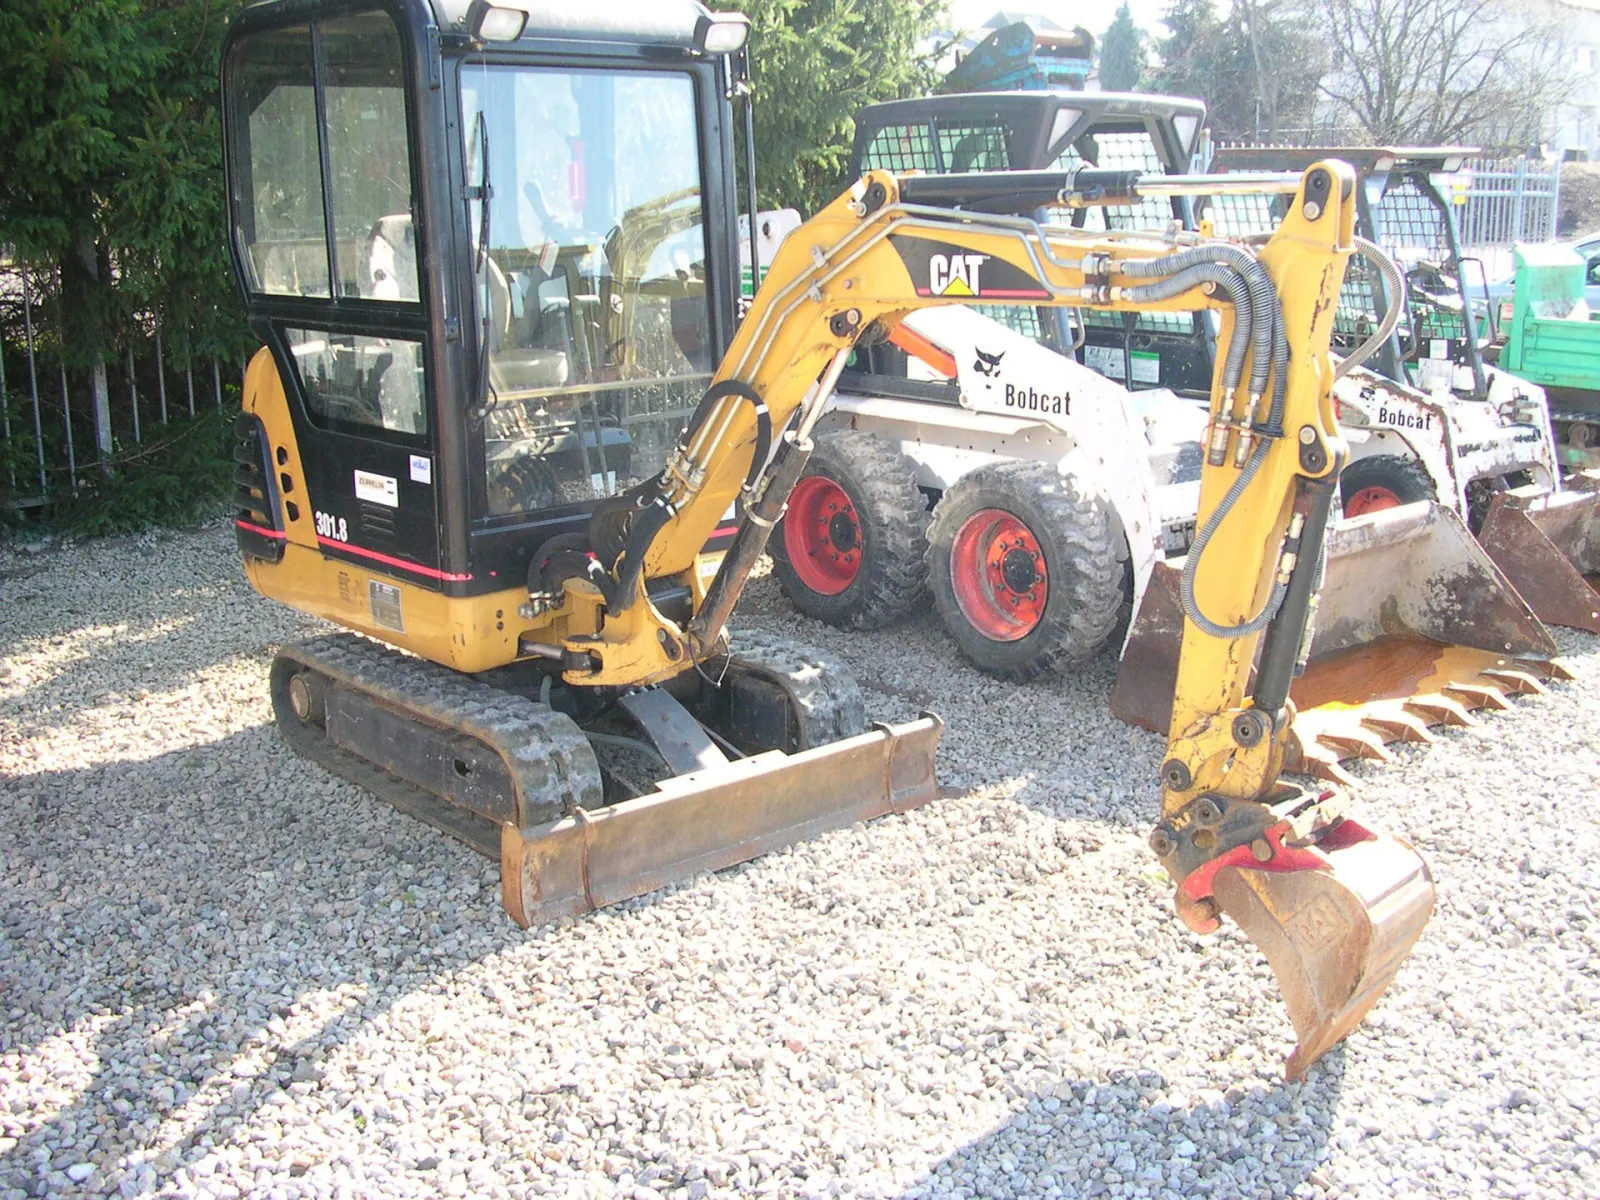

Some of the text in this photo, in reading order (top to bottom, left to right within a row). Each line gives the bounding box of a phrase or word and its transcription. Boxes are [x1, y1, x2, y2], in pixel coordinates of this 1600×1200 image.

[930, 254, 983, 296] CAT
[1005, 384, 1071, 416] Bobcat
[1379, 408, 1431, 431] Bobcat
[359, 476, 384, 490] ZEPPELIN
[315, 510, 348, 542] 301.8
